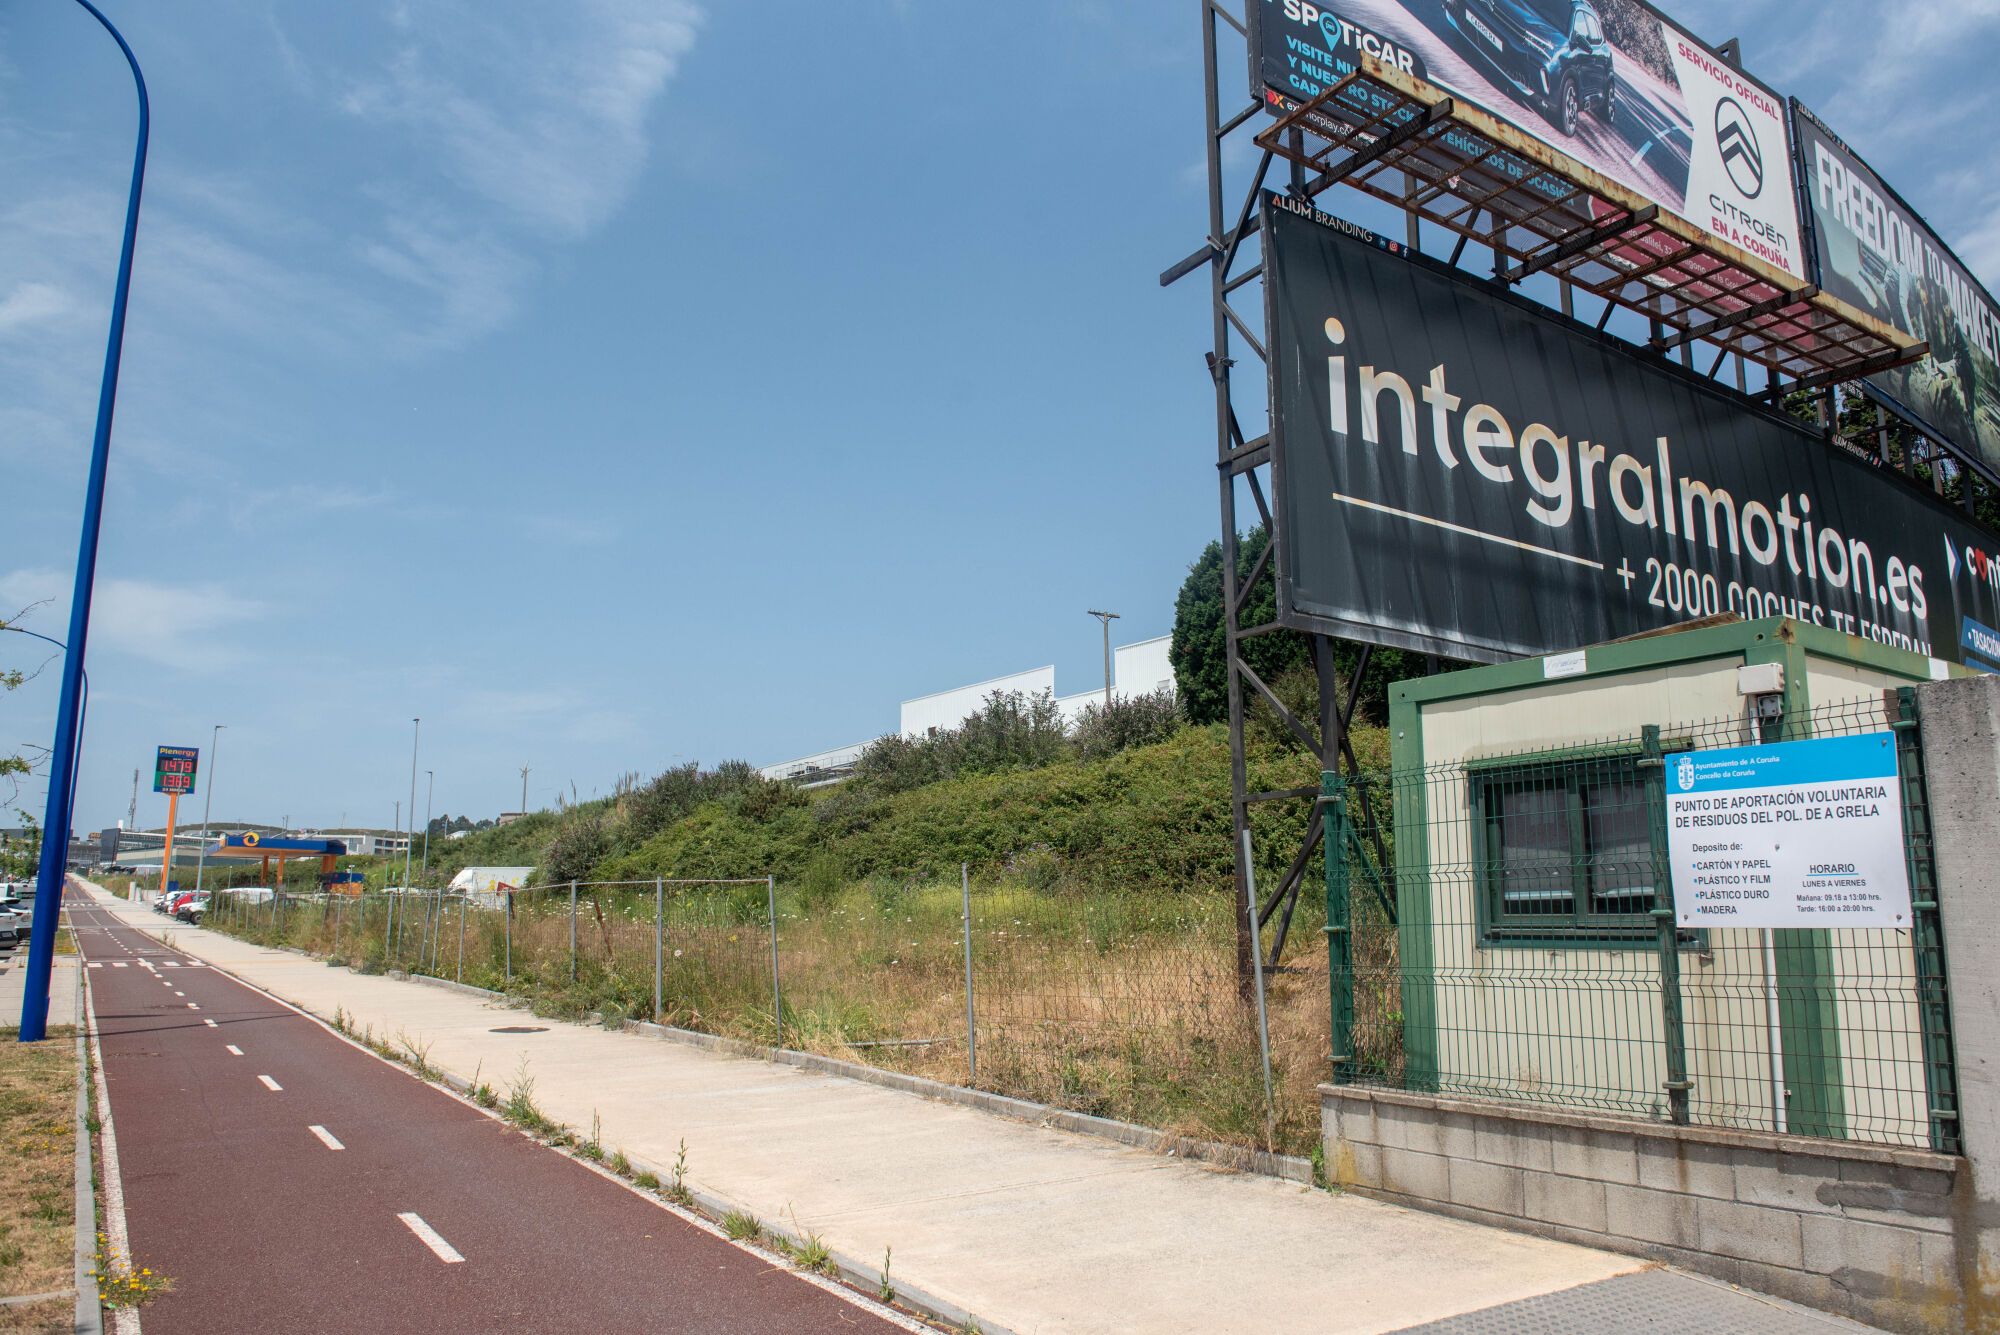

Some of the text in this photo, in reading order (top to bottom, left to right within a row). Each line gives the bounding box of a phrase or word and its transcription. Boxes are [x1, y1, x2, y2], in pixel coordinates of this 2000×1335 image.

[1285, 35, 1333, 66] VISITE
[1286, 53, 1298, 69] Y
[1677, 42, 1779, 121] SERVICIO OFICIAL
[1272, 194, 1374, 244] ALIUM BRANDING
[1815, 140, 1925, 278] FREEDOM
[1925, 242, 1943, 286] TO
[1711, 217, 1791, 272] EN A CORUÑA
[1324, 317, 1927, 620] integralmotion.es
[1645, 557, 1719, 617] 2000
[160, 747, 196, 757] Plenergy
[1695, 759, 1738, 771] Ayuntamiento
[1740, 758, 1748, 766] de
[1756, 755, 1780, 764] Coruña
[1695, 769, 1755, 780] Concello da Coruña
[1675, 785, 1887, 812] PUNTO DE APORTACIÓN VOLUNTARIA
[1675, 804, 1880, 828] DE RESIDUOS DEL POL. DE A GRELA
[1692, 841, 1743, 853] Deposito de:
[1697, 858, 1771, 870] CARTÓN Y PAPEL
[1809, 863, 1855, 874] HORARIO
[1698, 873, 1771, 885] PLÁSTICO Y FILM
[1802, 880, 1826, 888] LUNES
[1834, 879, 1866, 887] VIERNES
[1700, 888, 1770, 900] PLÁSTICO DURO
[1796, 893, 1823, 902] Mañana:
[1849, 893, 1867, 901] 13:00
[1868, 893, 1882, 901] hrs.
[1701, 905, 1737, 914] MADERA
[1797, 904, 1817, 912] Tarde:
[1818, 904, 1836, 912] 16:00
[1843, 904, 1861, 912] 20:00
[1861, 904, 1876, 912] hrs.
